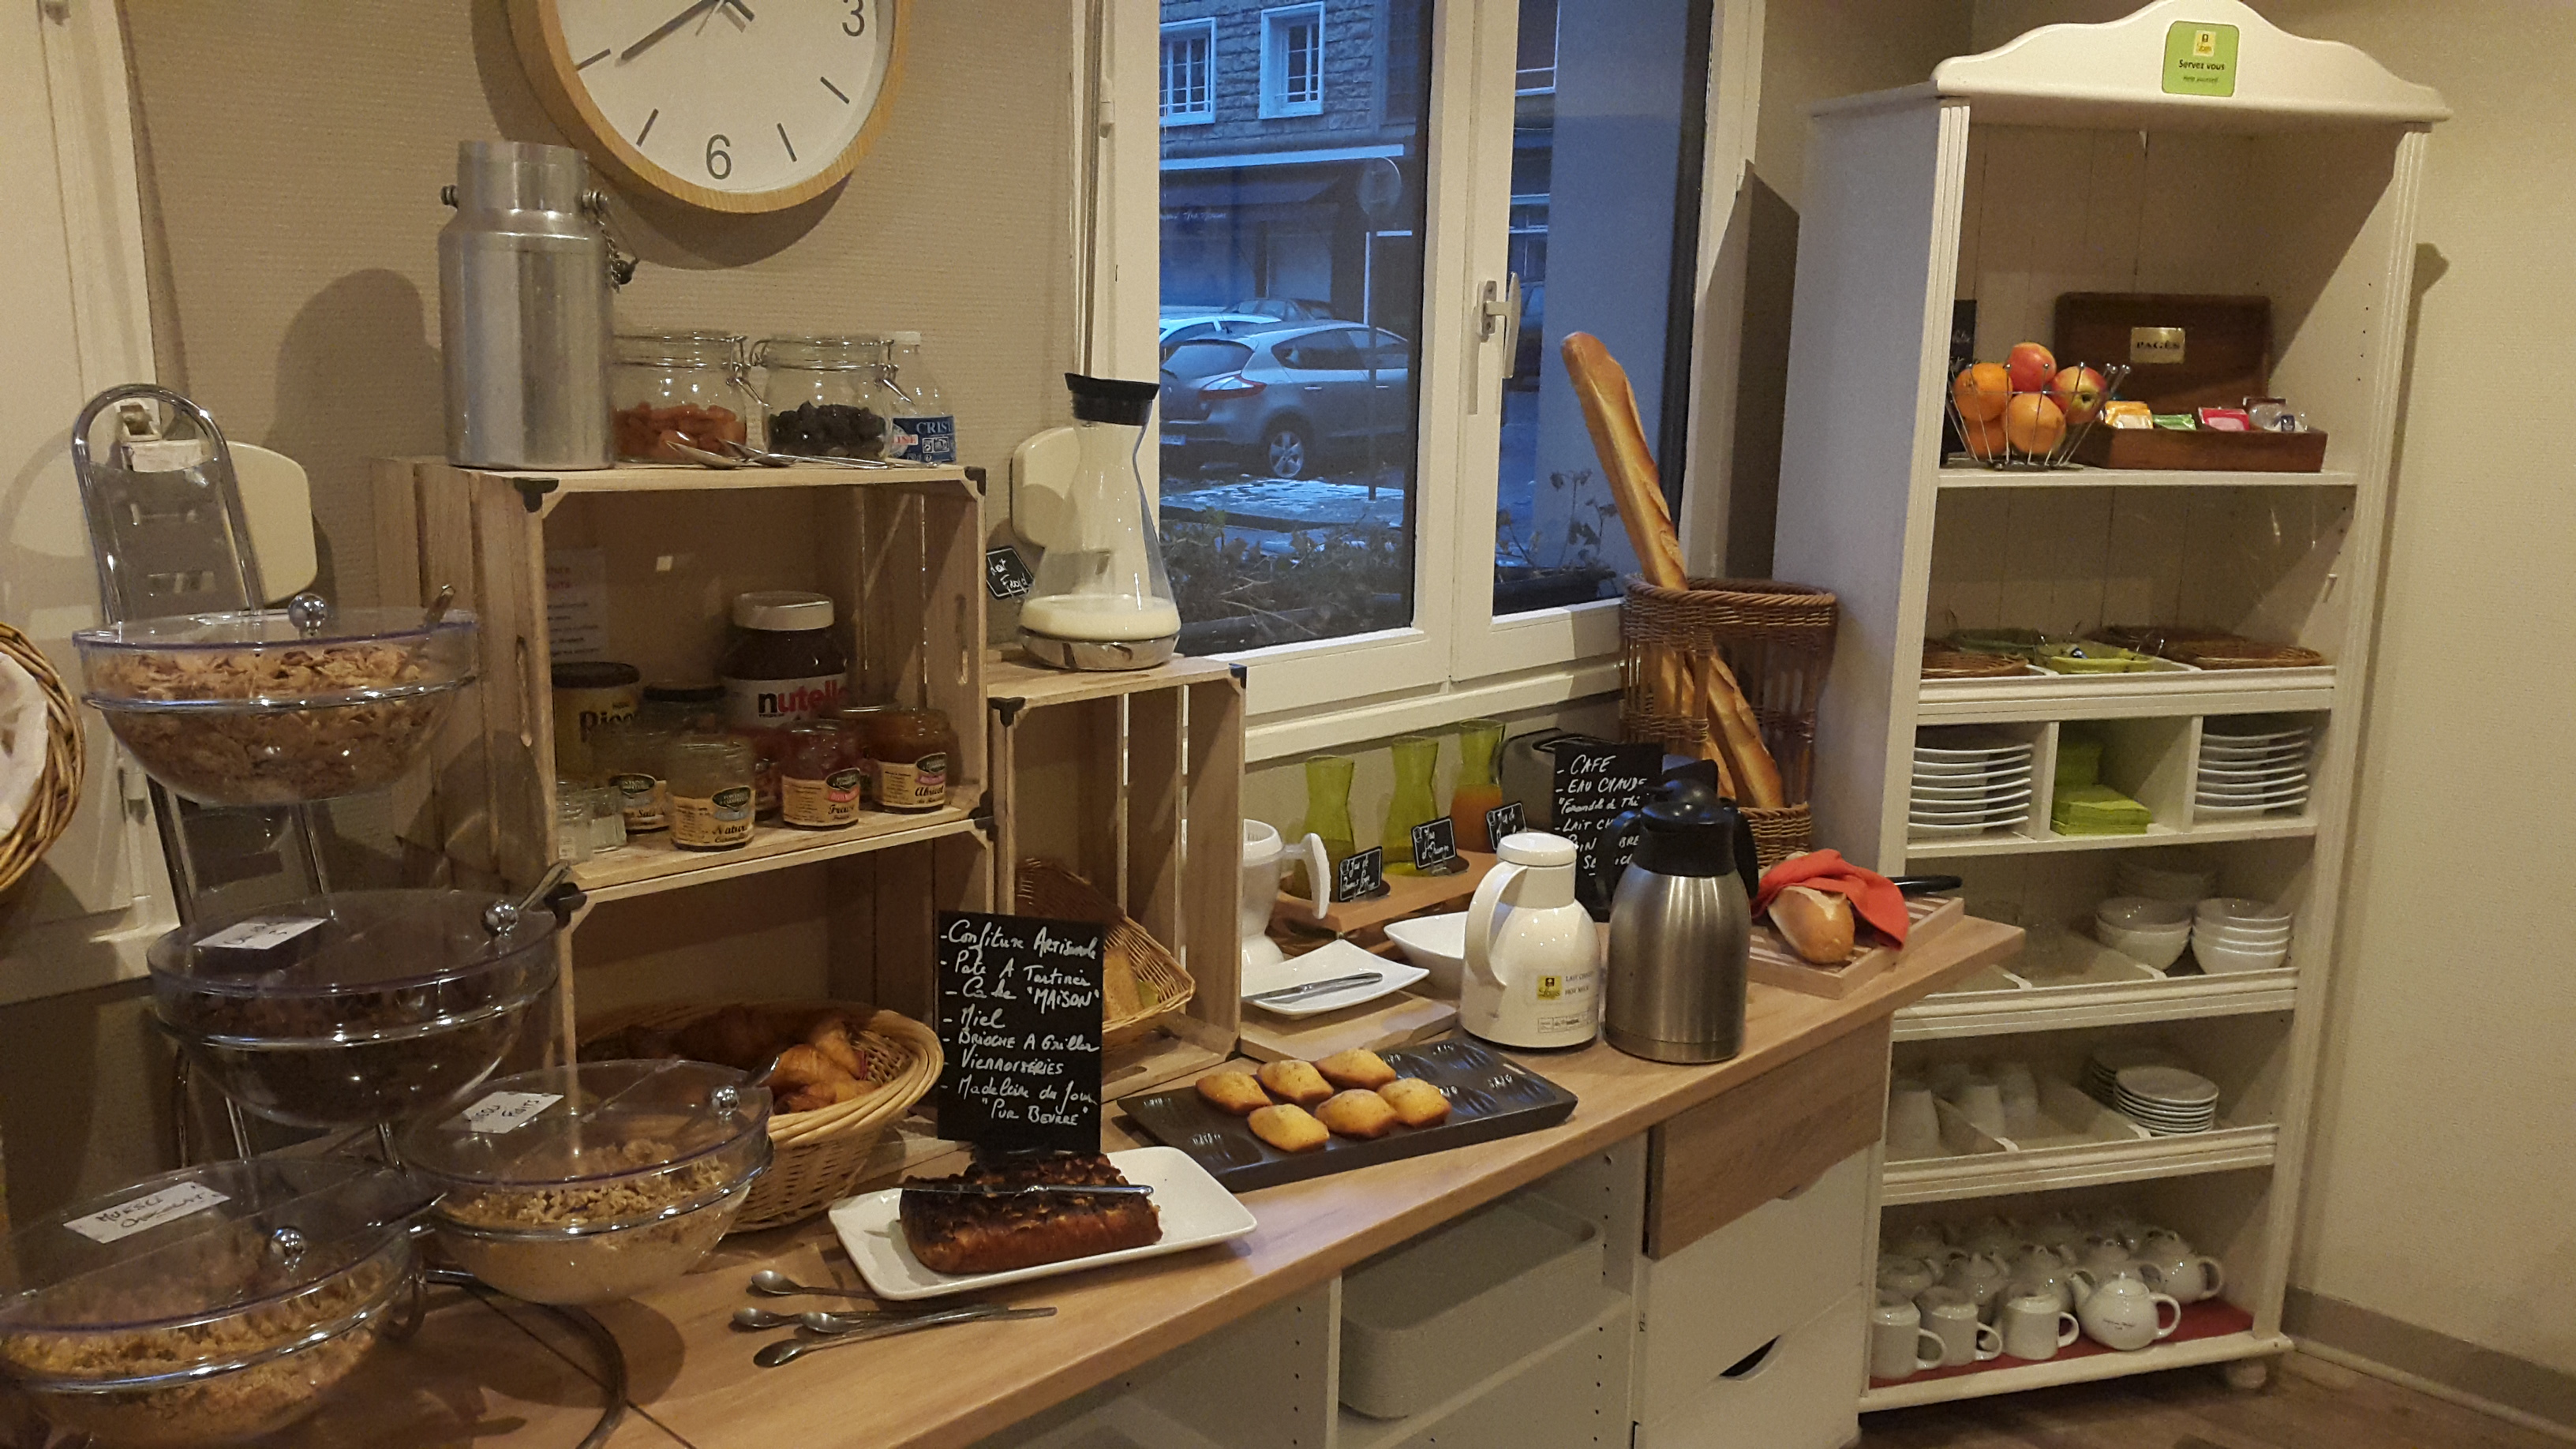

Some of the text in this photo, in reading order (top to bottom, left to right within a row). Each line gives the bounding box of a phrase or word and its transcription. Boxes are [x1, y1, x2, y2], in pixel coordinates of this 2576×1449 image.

[842, 0, 865, 36] 3
[2179, 59, 2204, 69] Servez
[706, 134, 732, 180] 6
[1570, 754, 1616, 775] CAFE
[1567, 777, 1647, 793] EAU CHAUDE
[960, 1003, 1005, 1028] Miel
[1023, 1033, 1035, 1050] A
